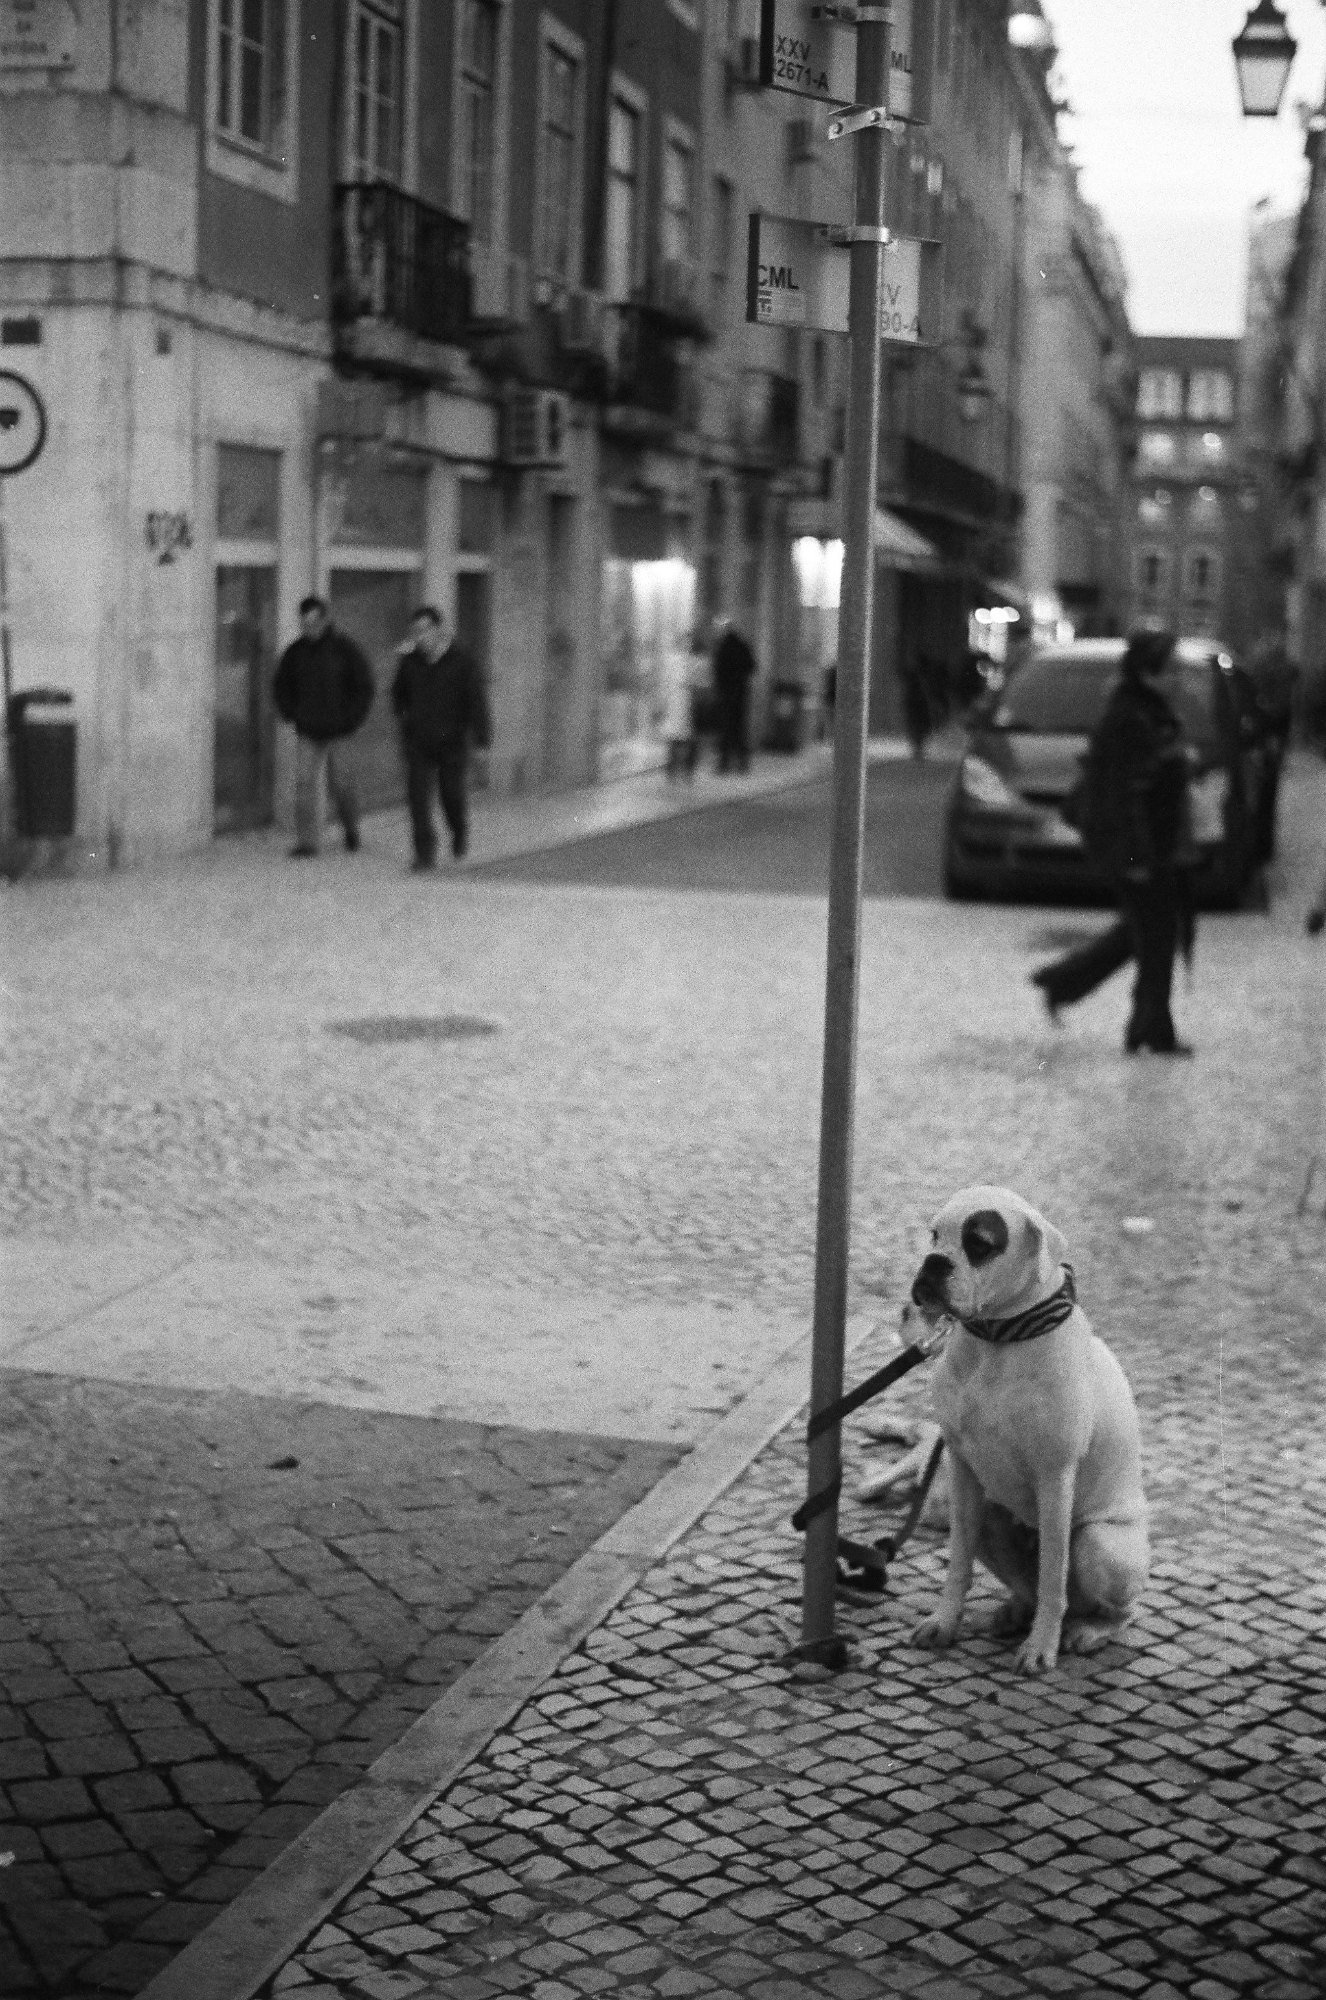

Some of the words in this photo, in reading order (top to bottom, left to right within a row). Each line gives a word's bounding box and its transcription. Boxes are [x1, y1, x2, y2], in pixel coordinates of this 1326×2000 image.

[777, 35, 811, 61] XXV
[777, 58, 829, 92] 2671-A
[891, 51, 913, 74] ML
[758, 264, 799, 290] CML
